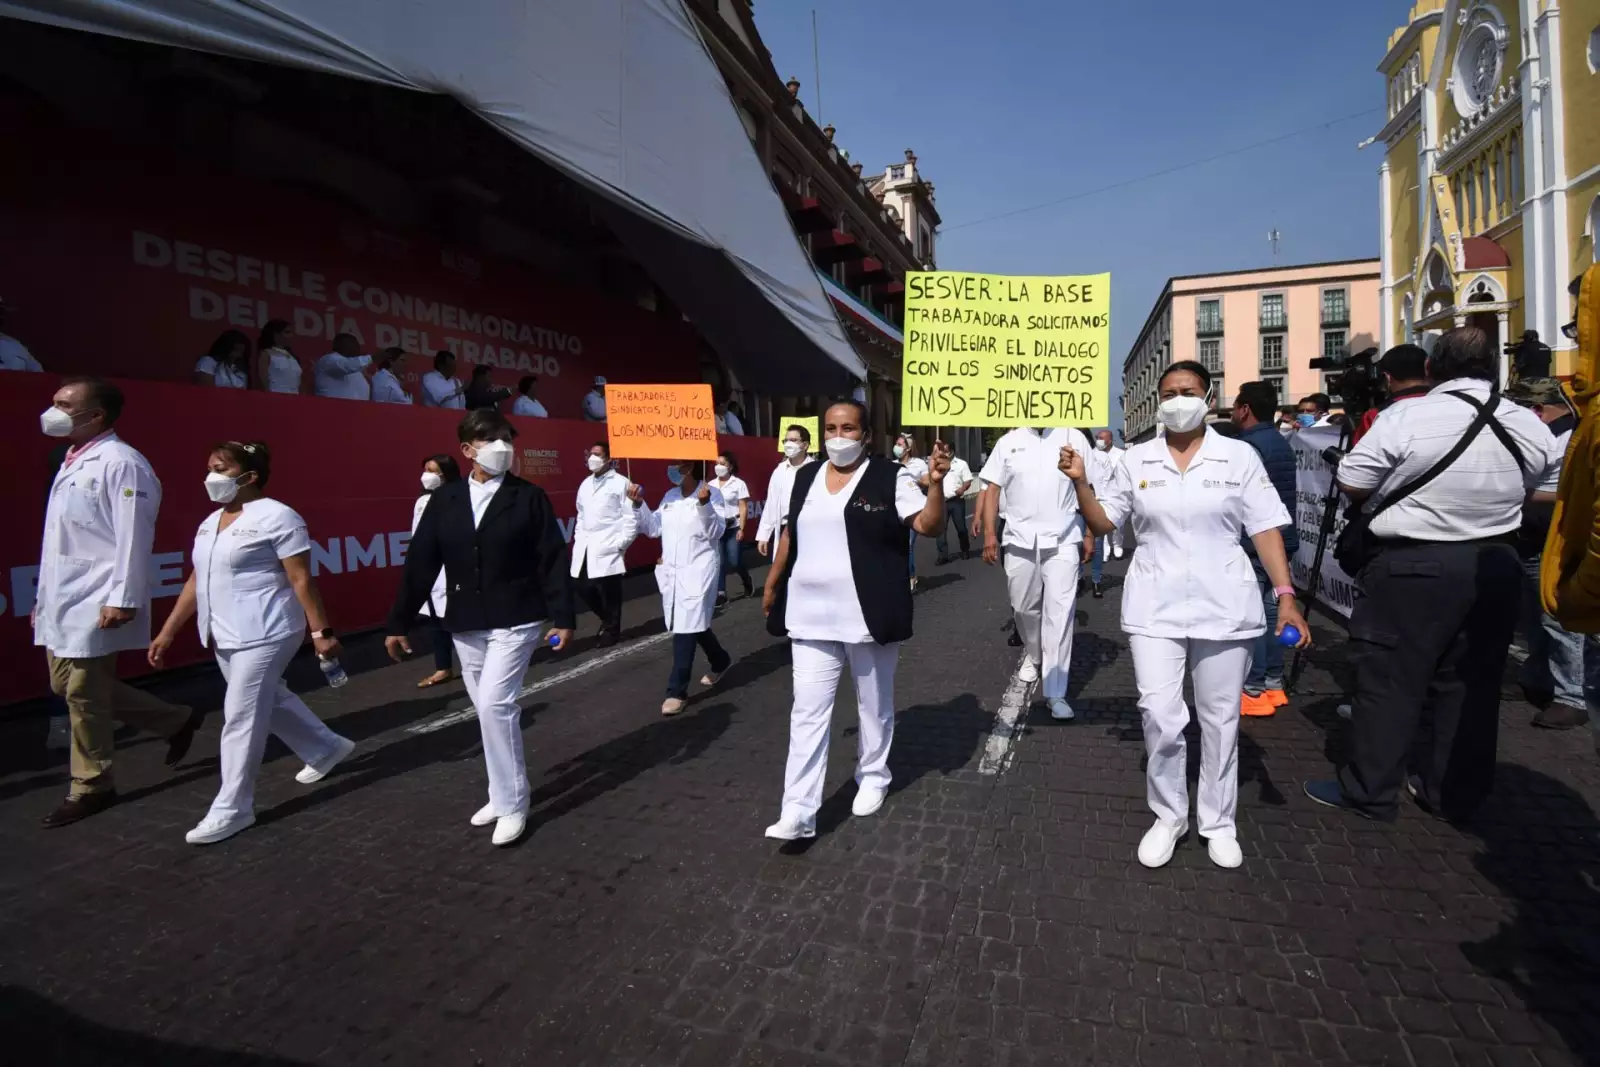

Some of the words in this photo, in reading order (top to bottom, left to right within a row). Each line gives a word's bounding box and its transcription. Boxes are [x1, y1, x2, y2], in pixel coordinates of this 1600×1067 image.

[132, 230, 327, 303] DESFILE
[337, 279, 583, 356] CONMEMORATIVO
[1044, 284, 1093, 303] BASE
[908, 307, 1020, 329] TRABAJADORA
[1027, 312, 1108, 330] SOLICITAMOS
[375, 323, 437, 357] DEL
[443, 337, 560, 377] TRABAJO
[909, 330, 997, 353] PRIVILEGIAR
[1007, 339, 1026, 355] EL
[1035, 340, 1099, 358] DIALOGO
[907, 360, 939, 376] CON
[948, 360, 980, 376] LOS
[994, 363, 1093, 384] SINDICATOS
[608, 389, 677, 401] TRABAJADORES
[611, 405, 660, 414] SINDICATOS
[612, 424, 634, 437] LOS
[636, 424, 675, 437] MISMOS
